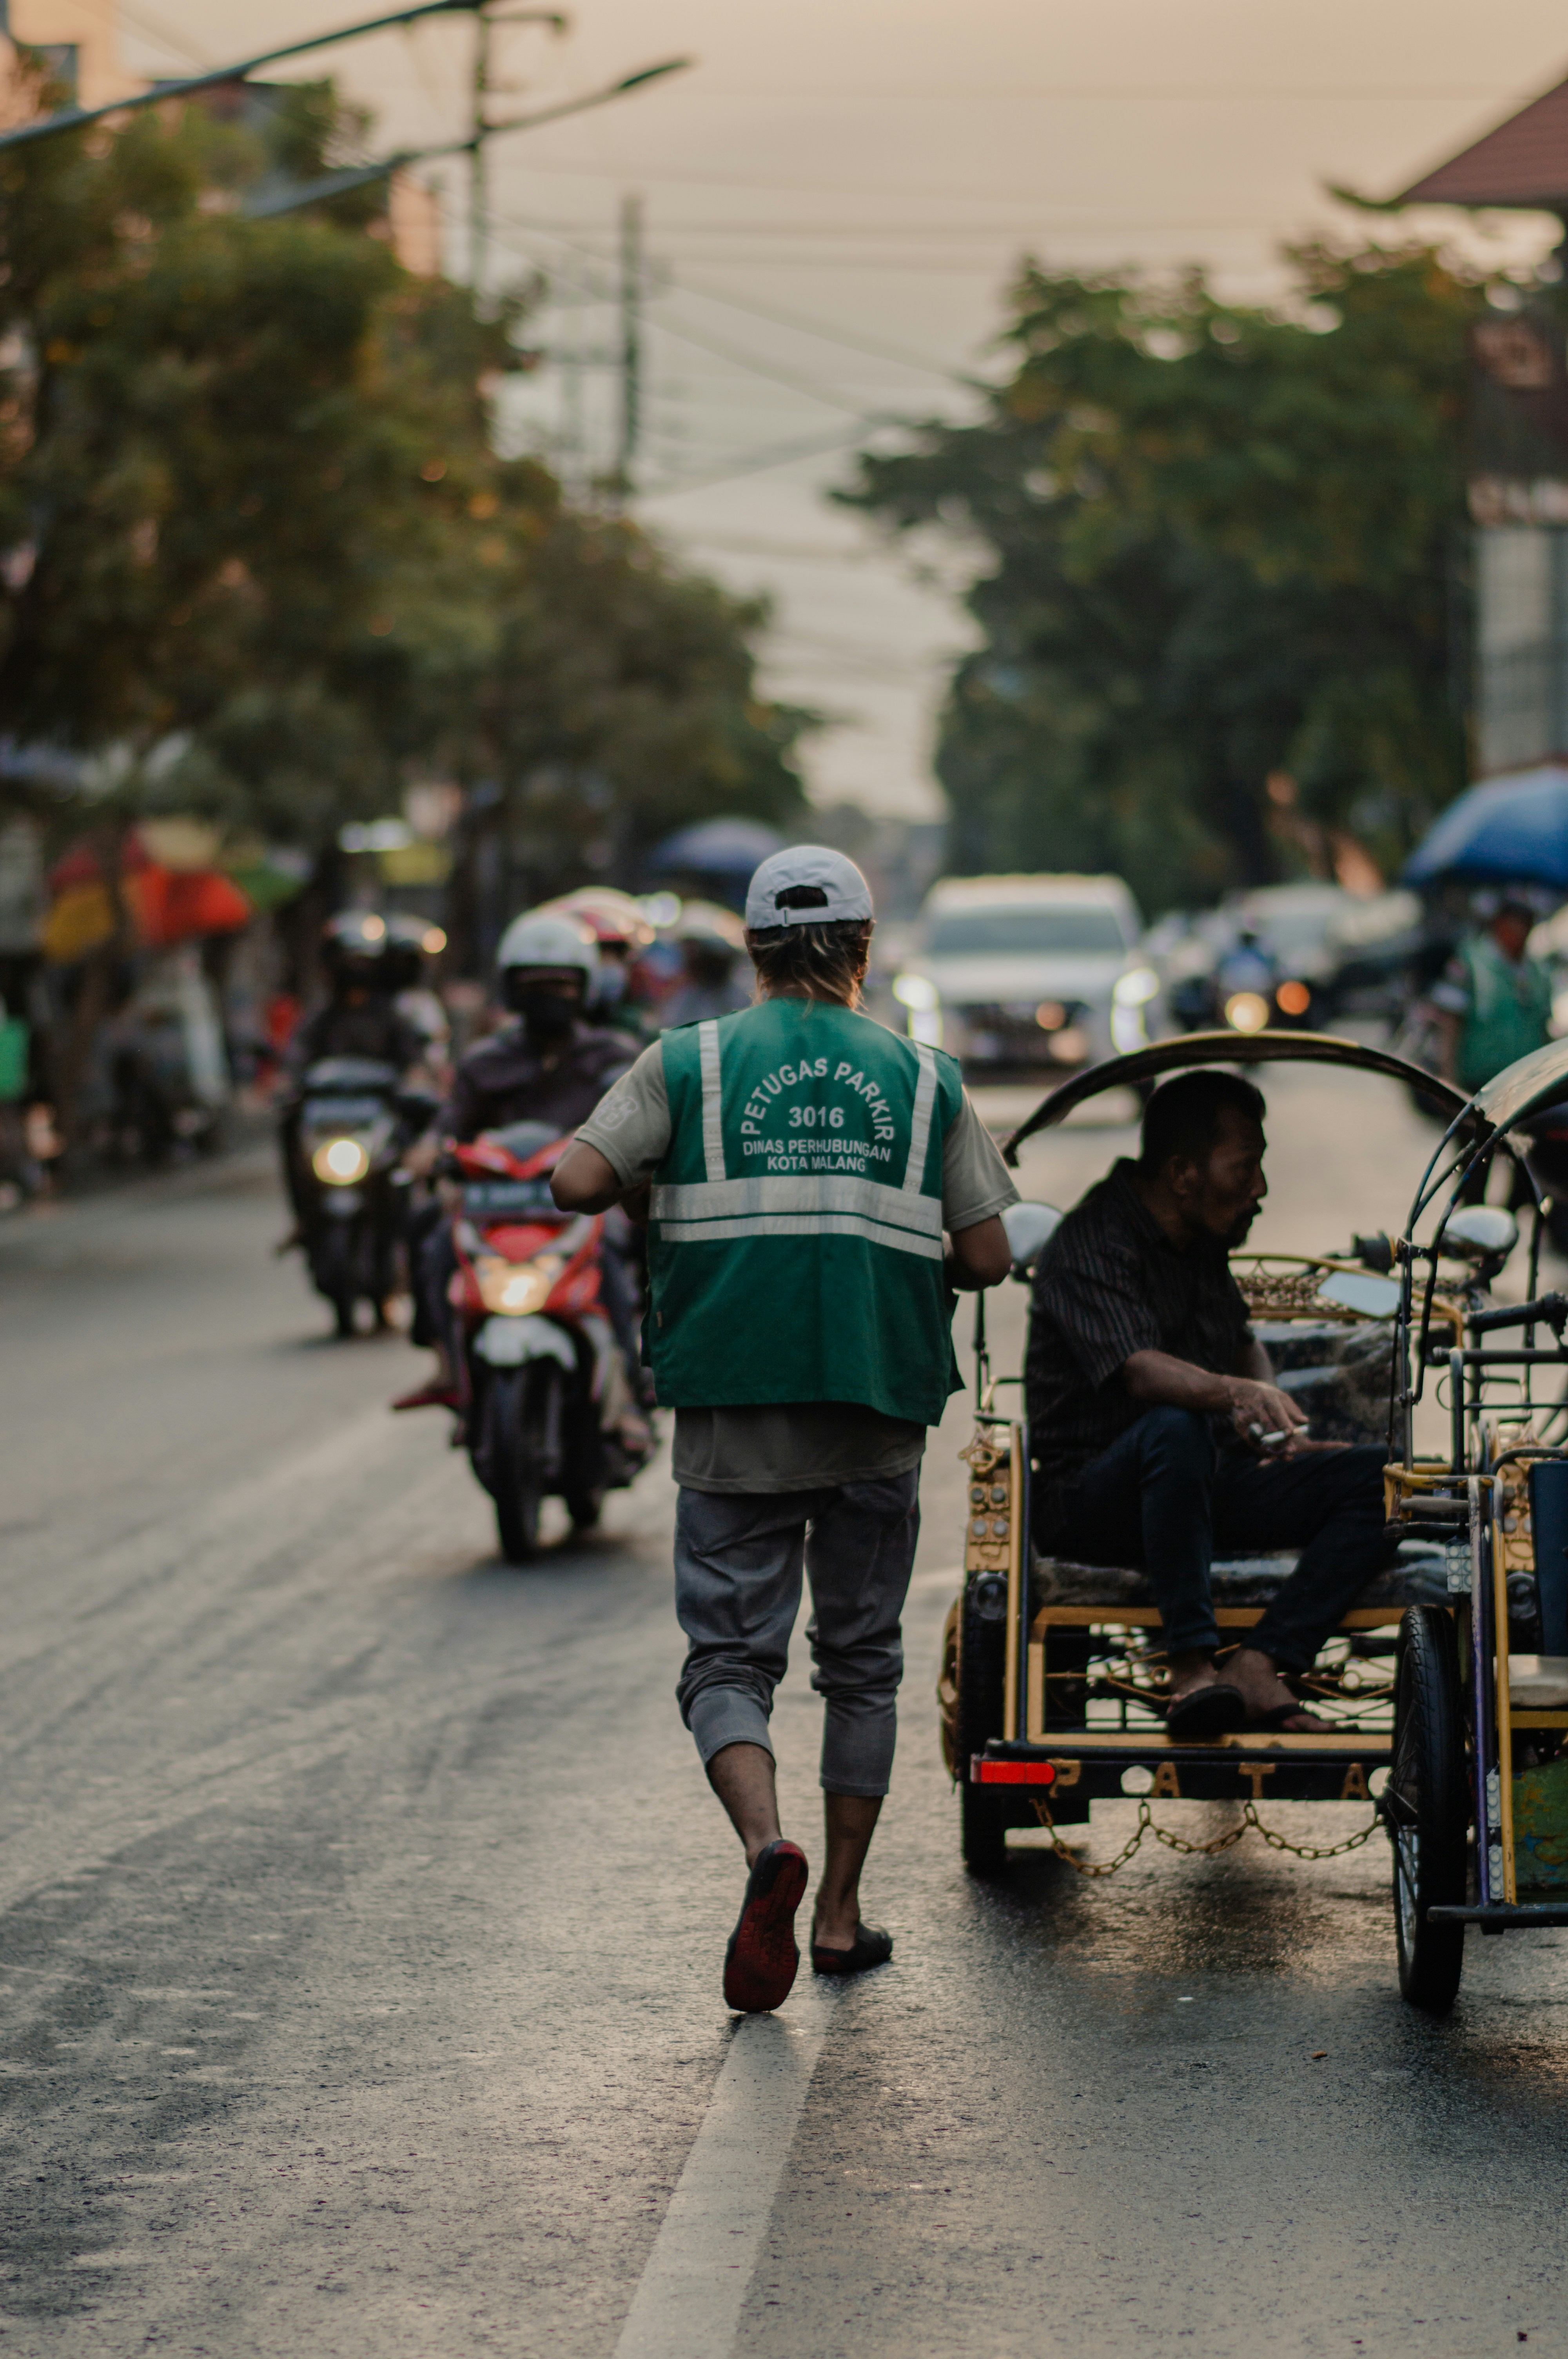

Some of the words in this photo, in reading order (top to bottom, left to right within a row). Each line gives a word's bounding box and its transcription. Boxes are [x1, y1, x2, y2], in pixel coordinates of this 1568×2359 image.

[741, 1058, 828, 1134] PETUGAS
[834, 1062, 894, 1140] PARKIR
[789, 1107, 844, 1128] 3016
[743, 1139, 784, 1156] DINAS
[788, 1139, 891, 1162] PERHUBUNGAN
[768, 1156, 808, 1170] KOTA
[811, 1156, 866, 1172] MALANG
